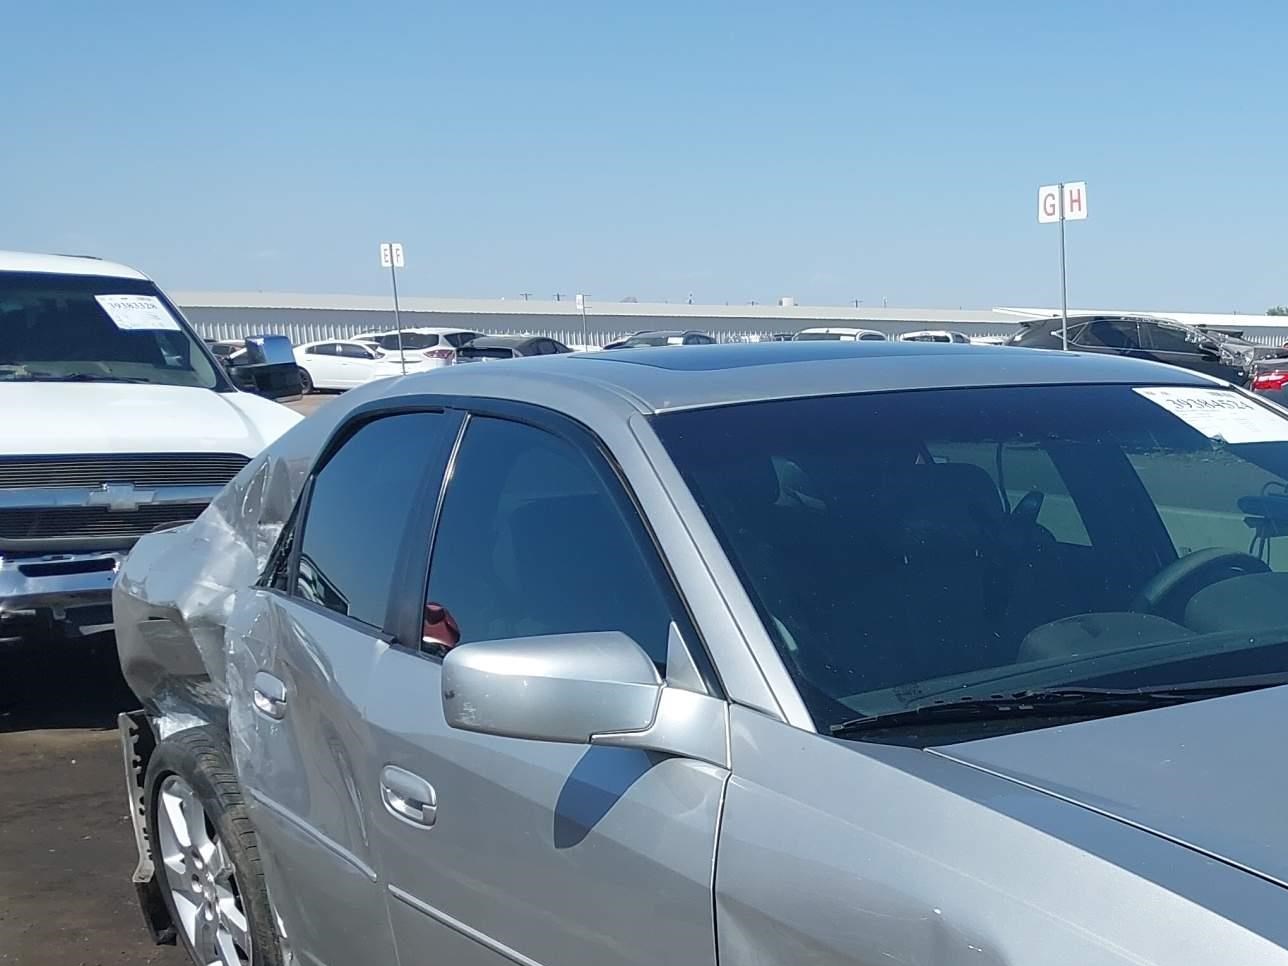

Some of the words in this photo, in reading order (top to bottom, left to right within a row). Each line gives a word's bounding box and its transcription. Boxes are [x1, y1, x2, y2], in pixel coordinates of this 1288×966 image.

[1043, 193, 1056, 217] G
[1069, 188, 1082, 213] H
[383, 248, 389, 263] E
[395, 248, 401, 264] F
[1166, 398, 1255, 411] 39384524
